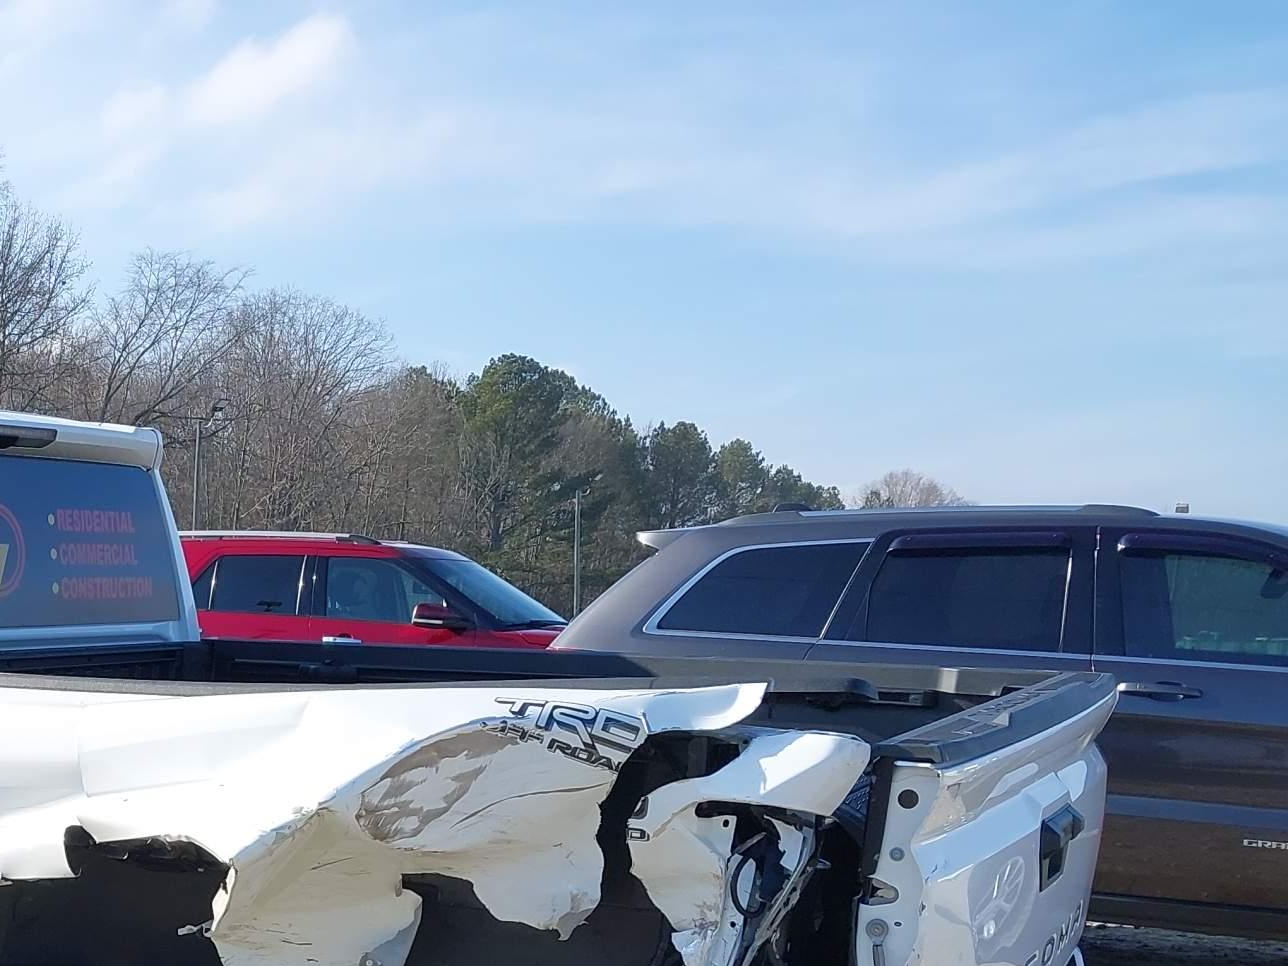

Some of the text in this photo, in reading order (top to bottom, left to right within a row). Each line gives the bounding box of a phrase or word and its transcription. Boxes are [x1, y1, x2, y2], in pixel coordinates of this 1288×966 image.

[56, 509, 136, 534] RESIDENTIAL
[59, 543, 138, 566] COMMERCIAL
[62, 576, 153, 599] CONSTRUCTION
[495, 696, 650, 756] TRD
[1242, 839, 1288, 850] GRA
